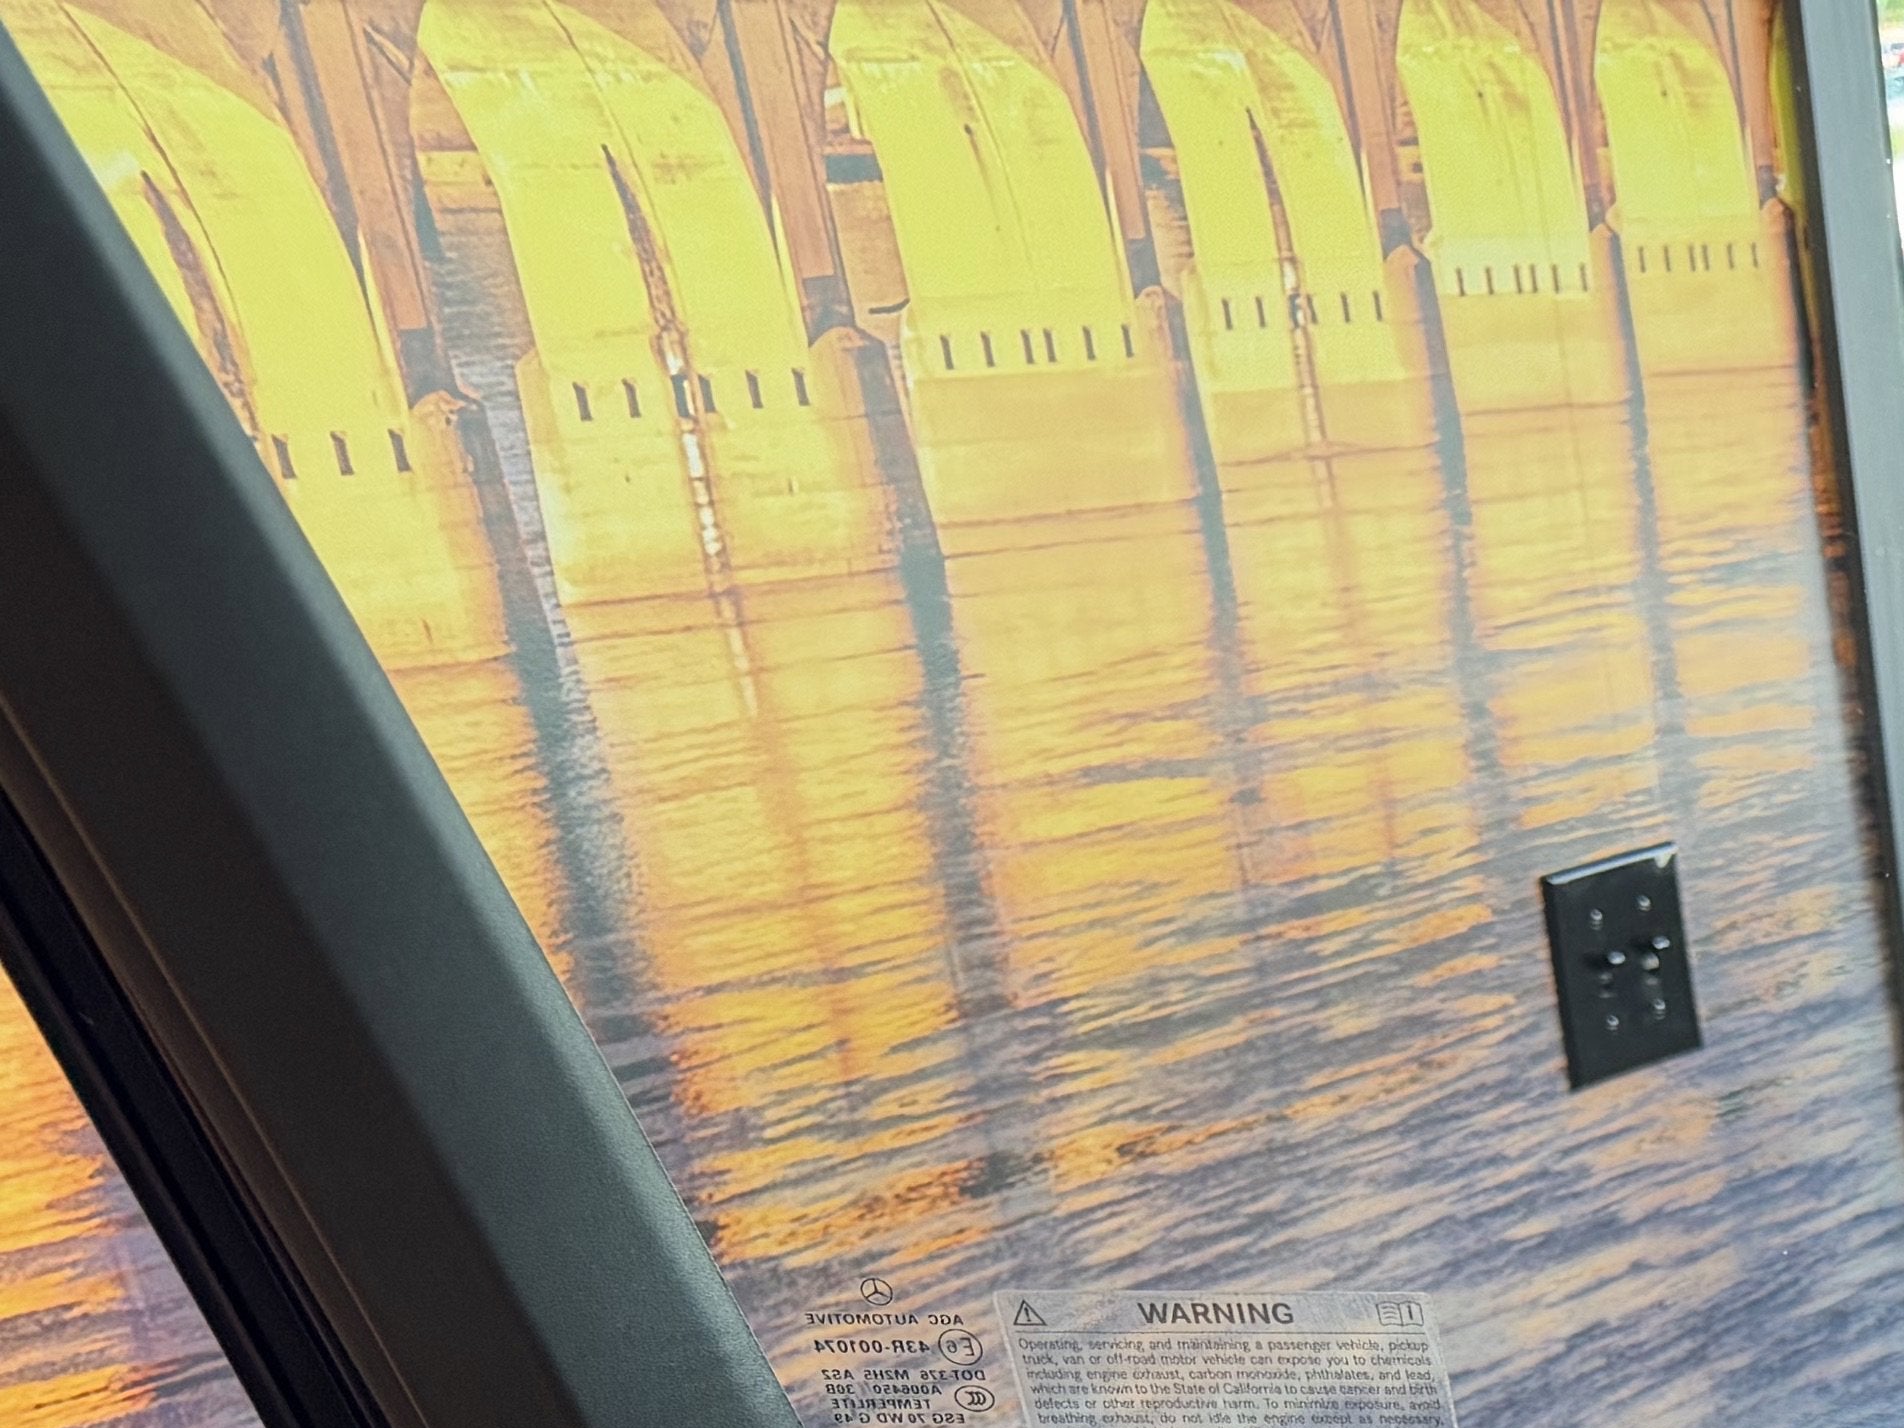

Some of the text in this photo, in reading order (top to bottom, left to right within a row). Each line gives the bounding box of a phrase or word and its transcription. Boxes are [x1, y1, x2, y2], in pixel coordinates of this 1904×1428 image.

[1138, 1303, 1294, 1324] WARNING
[1019, 1338, 1083, 1352] Operating,
[1063, 1357, 1084, 1365] van
